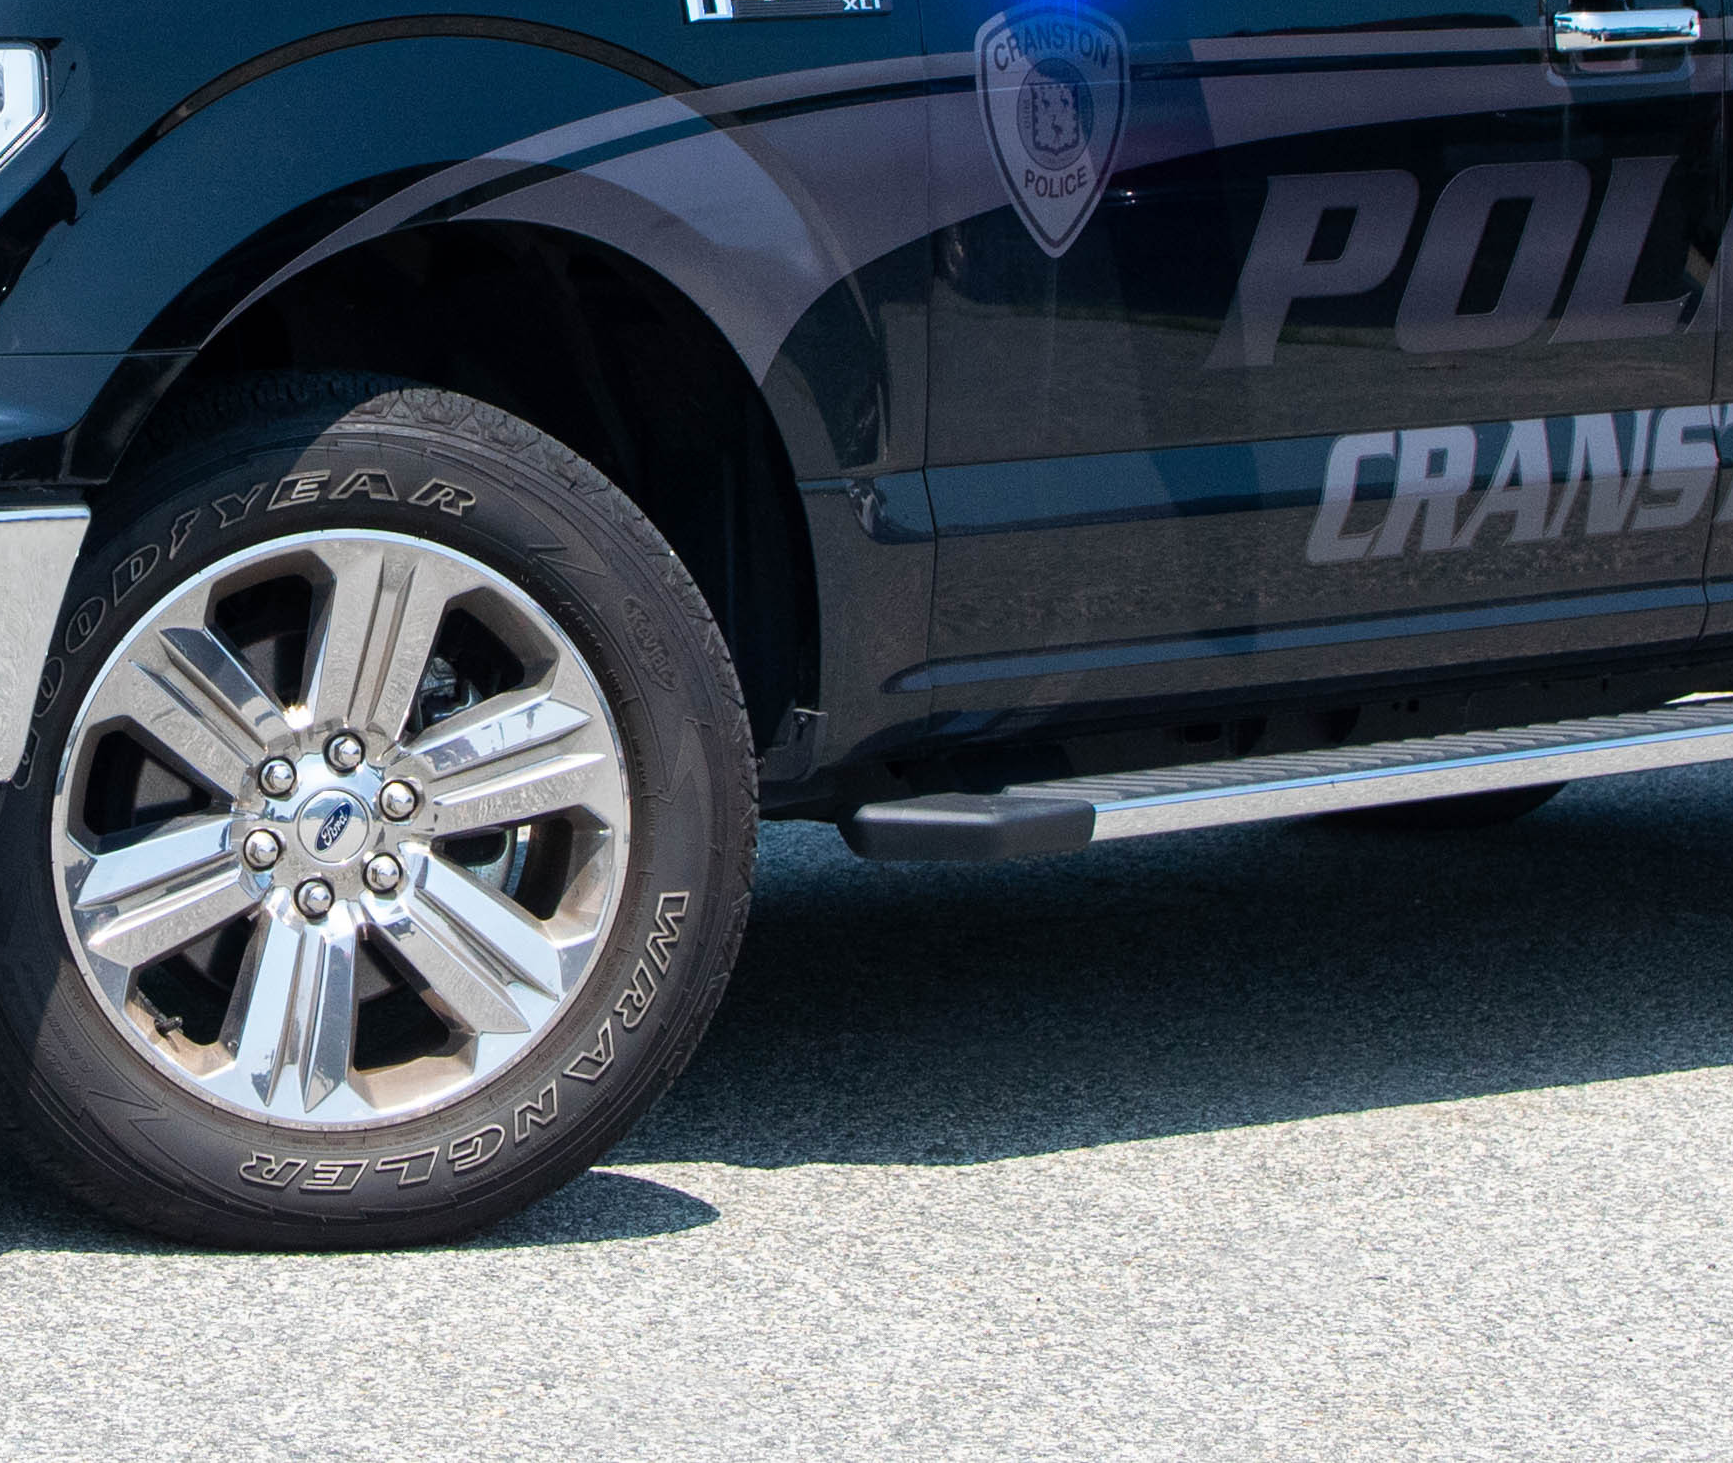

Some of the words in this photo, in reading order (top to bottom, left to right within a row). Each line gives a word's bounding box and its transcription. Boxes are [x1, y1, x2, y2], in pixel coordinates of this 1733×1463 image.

[993, 23, 1110, 71] CRANSTON
[1024, 166, 1088, 198] POLICE
[321, 809, 348, 847] Ford
[239, 890, 690, 1192] WRANGLER
